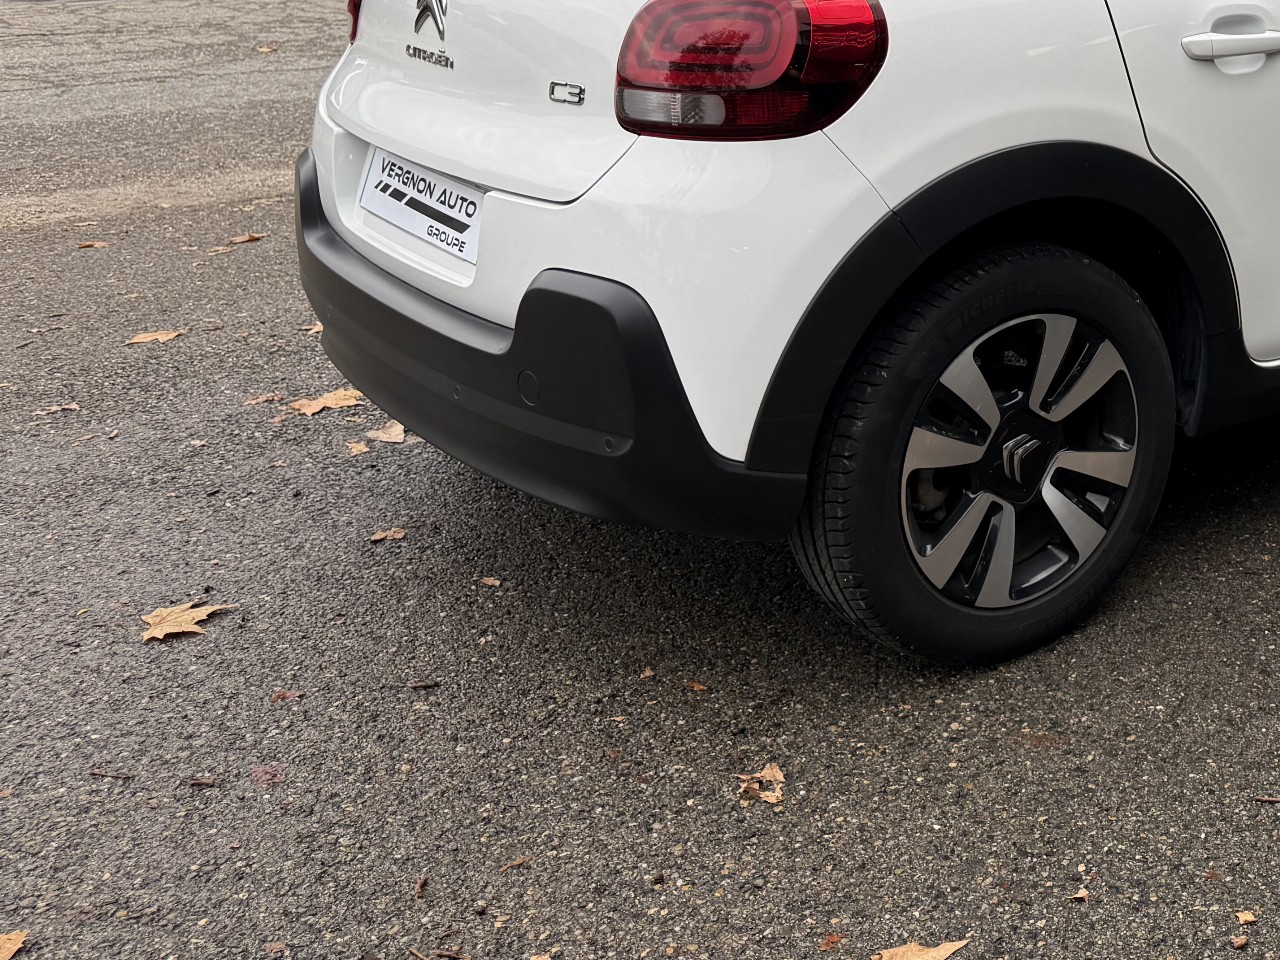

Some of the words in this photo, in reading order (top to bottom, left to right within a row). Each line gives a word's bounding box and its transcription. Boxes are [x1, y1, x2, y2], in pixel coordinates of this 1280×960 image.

[549, 81, 585, 105] C3
[381, 157, 437, 199] VERGNON
[436, 188, 477, 218] AUTO
[427, 225, 466, 253] GROUPE
